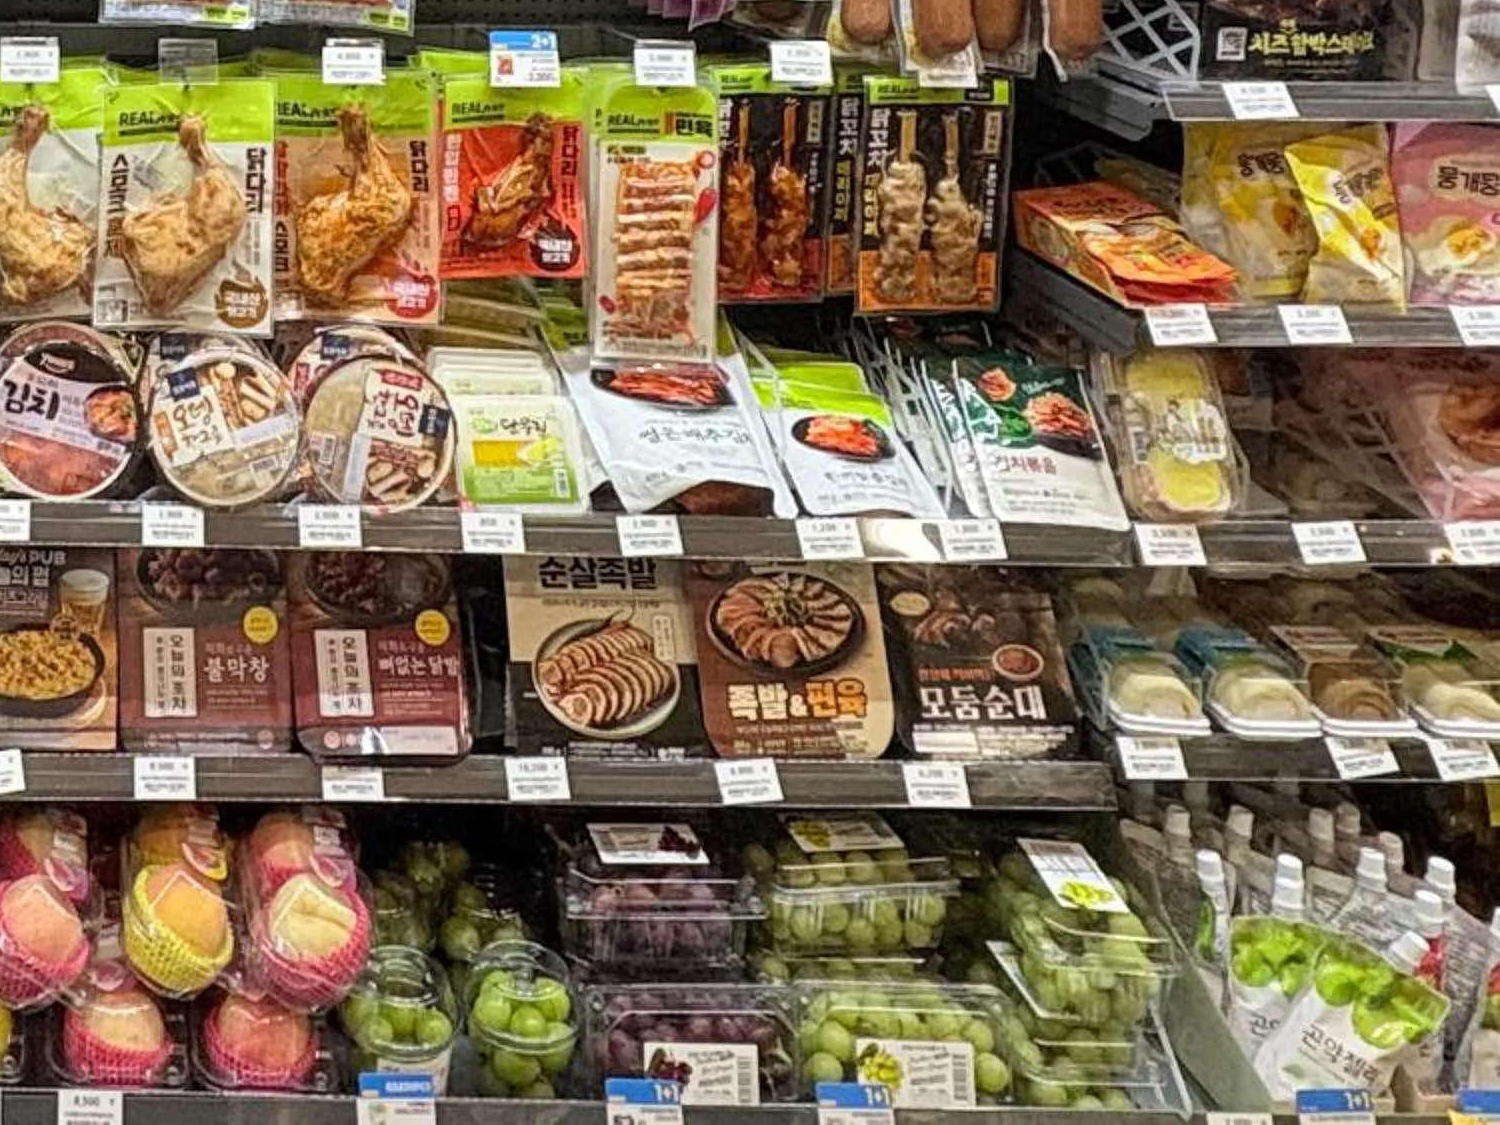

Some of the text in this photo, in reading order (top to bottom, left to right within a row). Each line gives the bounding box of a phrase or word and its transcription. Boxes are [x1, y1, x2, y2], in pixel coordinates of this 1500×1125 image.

[3, 378, 61, 421] 김치
[28, 549, 67, 566] PUB
[538, 557, 658, 590] 순살족발
[203, 655, 271, 684] 불막창
[920, 685, 1049, 722] 모둠순대
[654, 1084, 682, 1103] 1+1
[864, 1084, 891, 1104] 1+1
